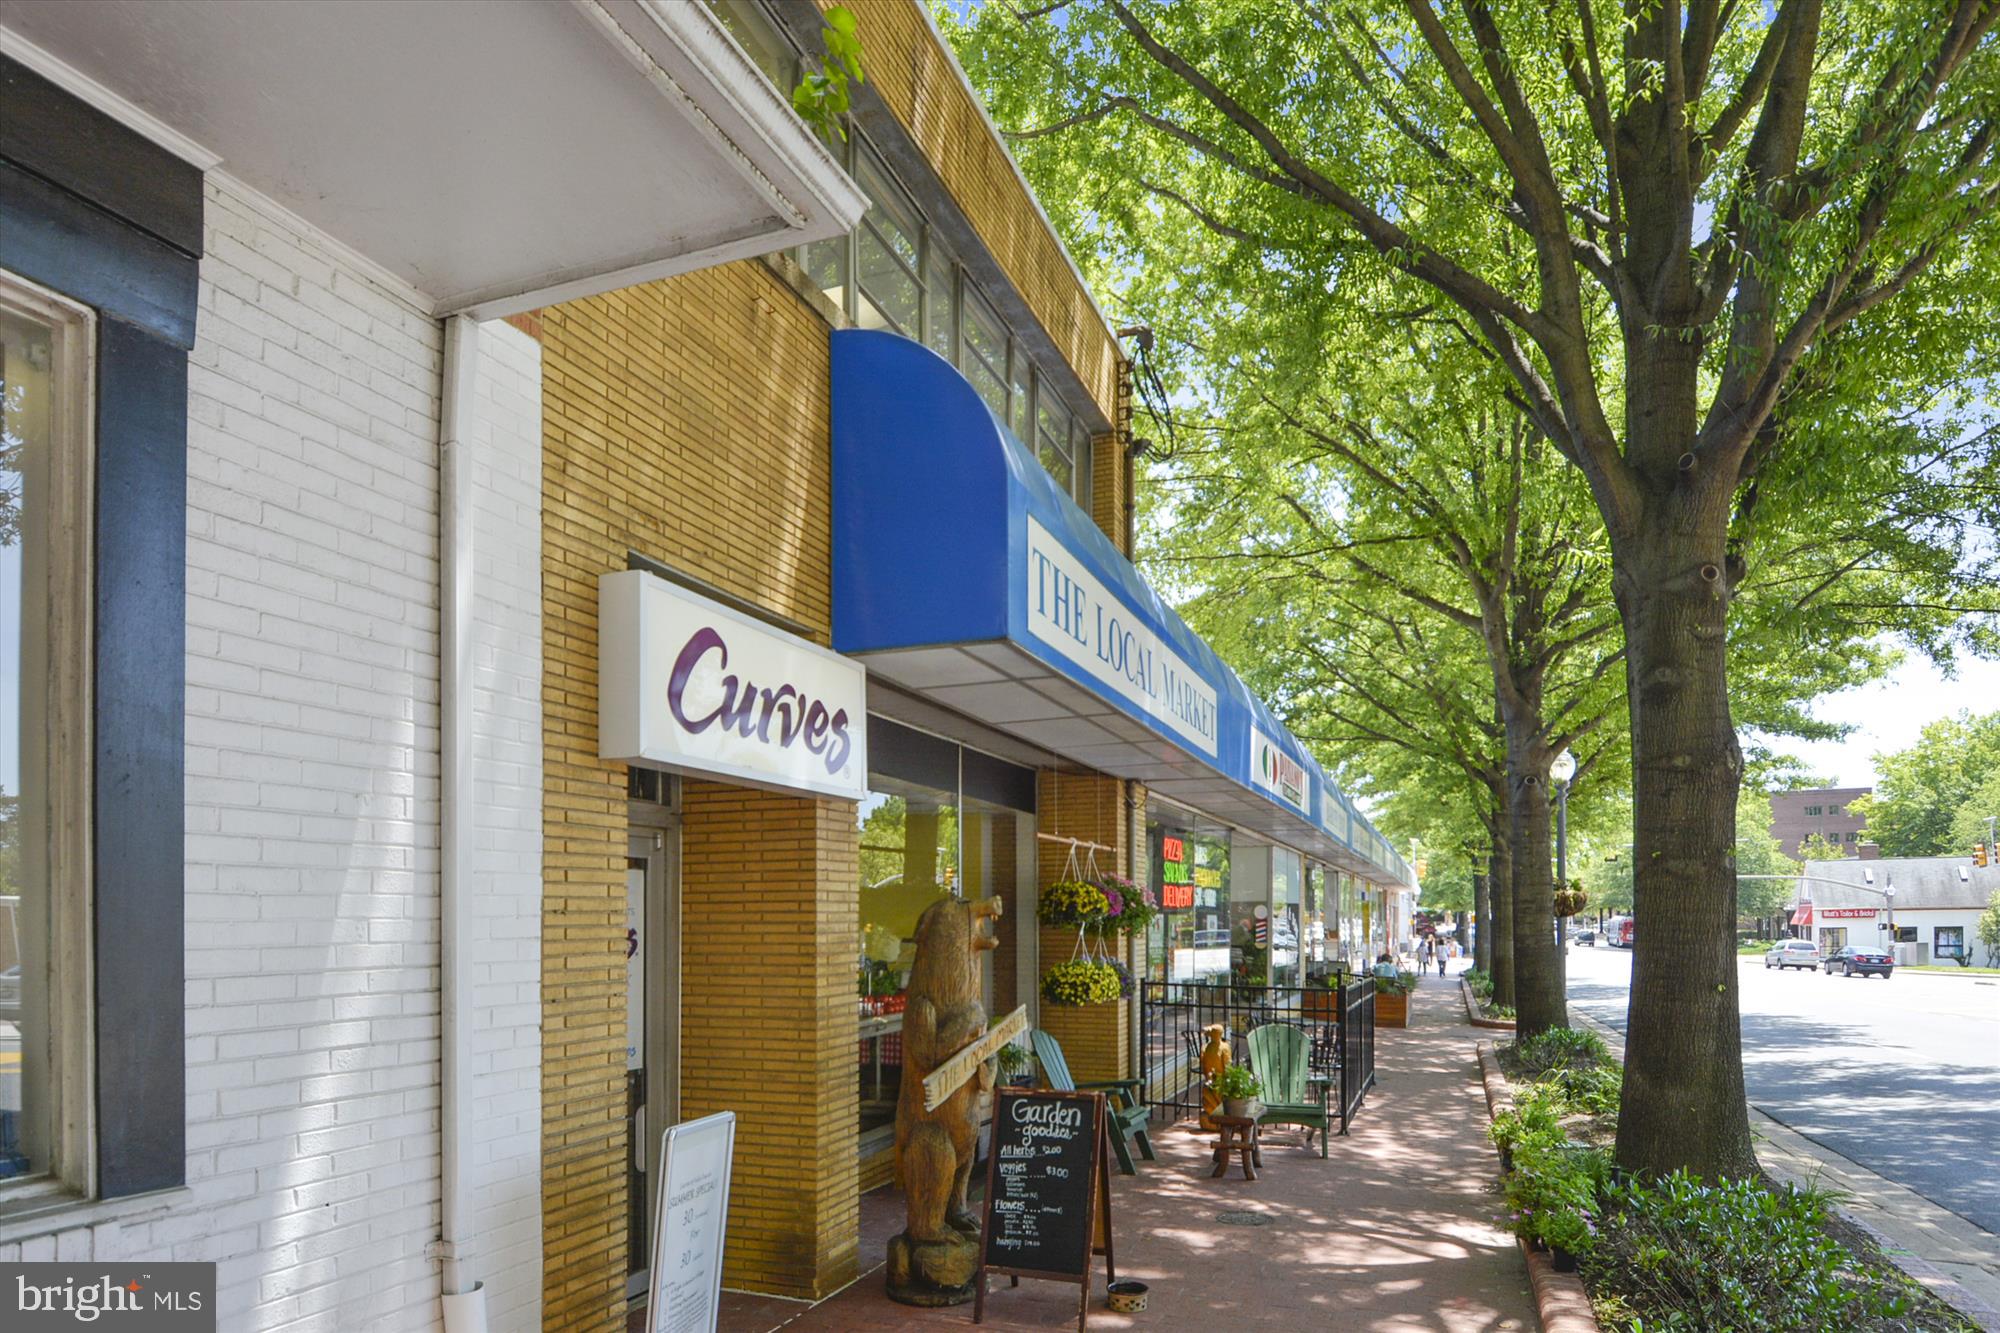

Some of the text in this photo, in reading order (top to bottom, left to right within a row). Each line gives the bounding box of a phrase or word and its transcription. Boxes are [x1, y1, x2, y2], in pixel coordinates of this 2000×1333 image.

[1033, 547, 1217, 741] THE LOCAL MARKET
[667, 626, 851, 775] Curves
[1163, 837, 1184, 862] PIZZA
[1163, 885, 1193, 908] DELIVERY
[1012, 1099, 1081, 1126] Garden
